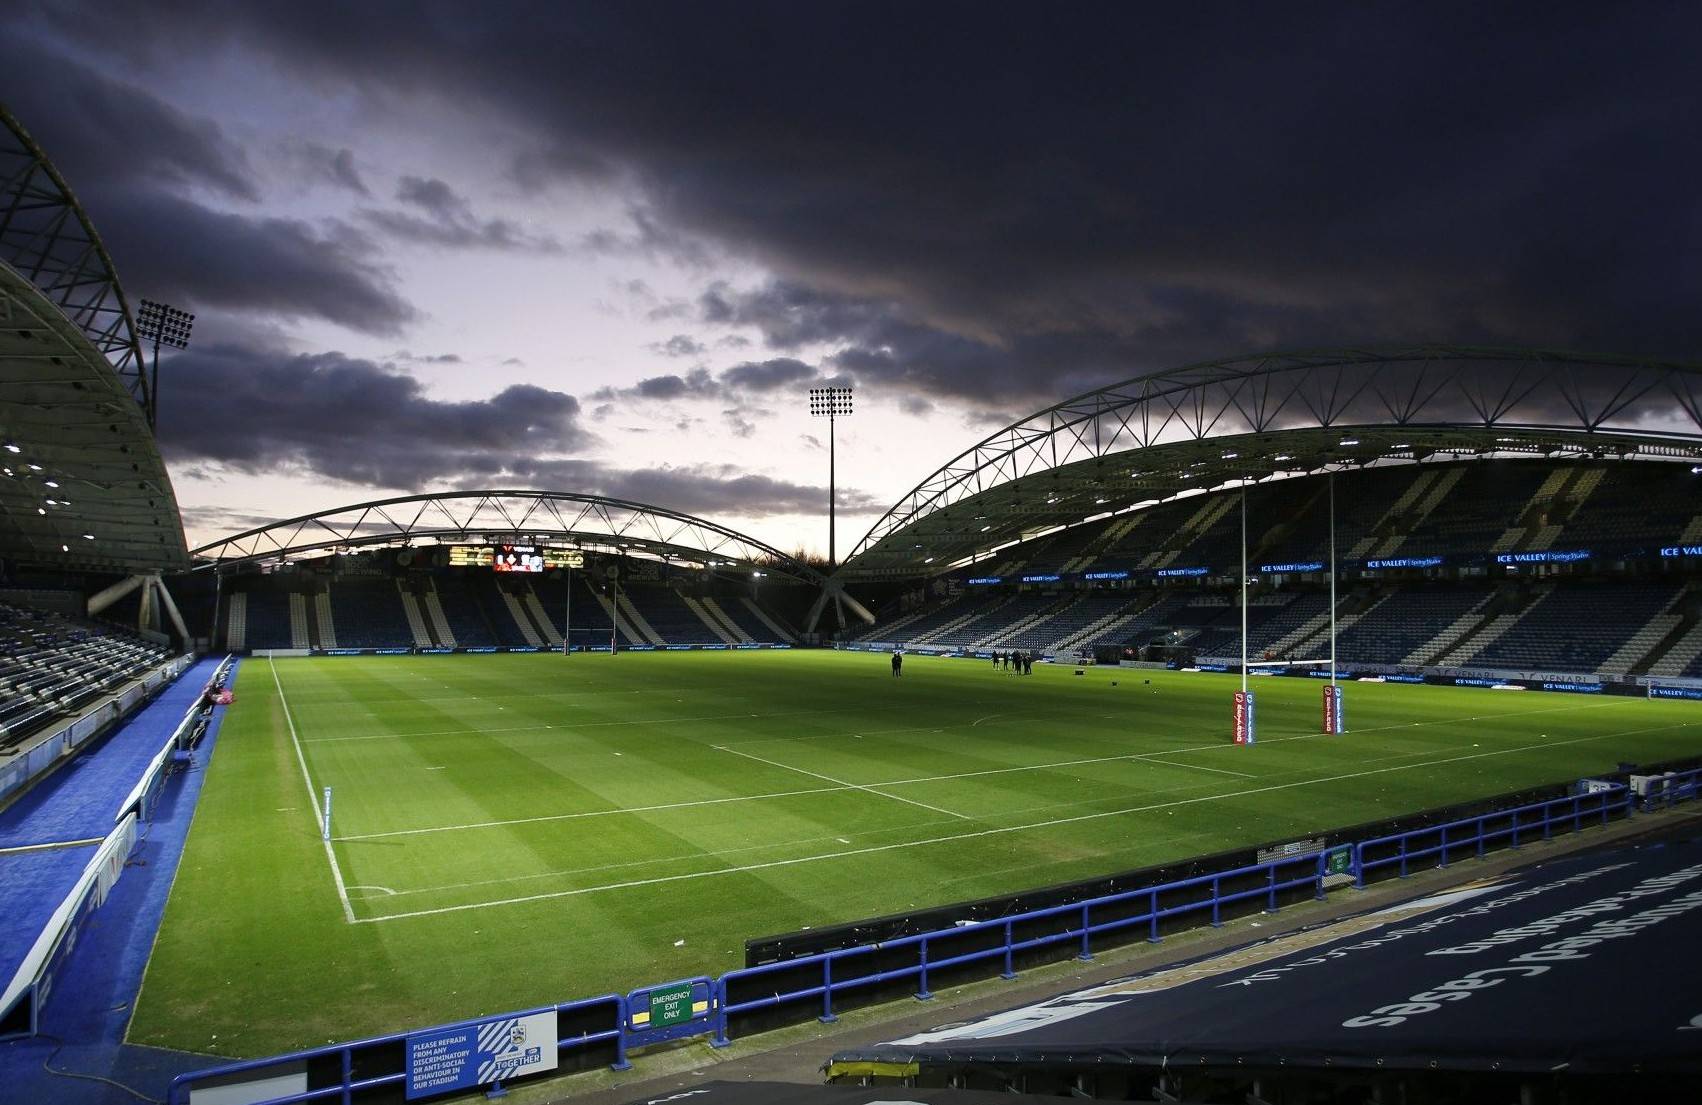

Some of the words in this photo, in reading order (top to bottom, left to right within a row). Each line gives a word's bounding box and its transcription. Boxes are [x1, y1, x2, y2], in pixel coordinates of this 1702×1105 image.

[1515, 553, 1546, 562] VALLEY
[1661, 548, 1679, 556] ICE
[1381, 559, 1407, 567] VALLEY
[1425, 886, 1676, 956] Packaging
[653, 991, 691, 1005] EMERGENCY
[1342, 965, 1552, 1029] Cases
[665, 1002, 679, 1011] EXIT
[664, 1010, 680, 1020] ONLY
[413, 1041, 438, 1051] PLEASE
[438, 1035, 467, 1046] REFRAIN
[413, 1049, 433, 1059] FROM
[433, 1047, 448, 1055] ANY
[413, 1050, 470, 1067] DISCRIMINATORY
[424, 1058, 466, 1073] ANTI-SOCIAL
[496, 1054, 540, 1070] TOGETHER
[413, 1068, 451, 1082] BEHAVIOUR
[413, 1081, 428, 1090] OUR
[428, 1075, 459, 1087] STADIUM
